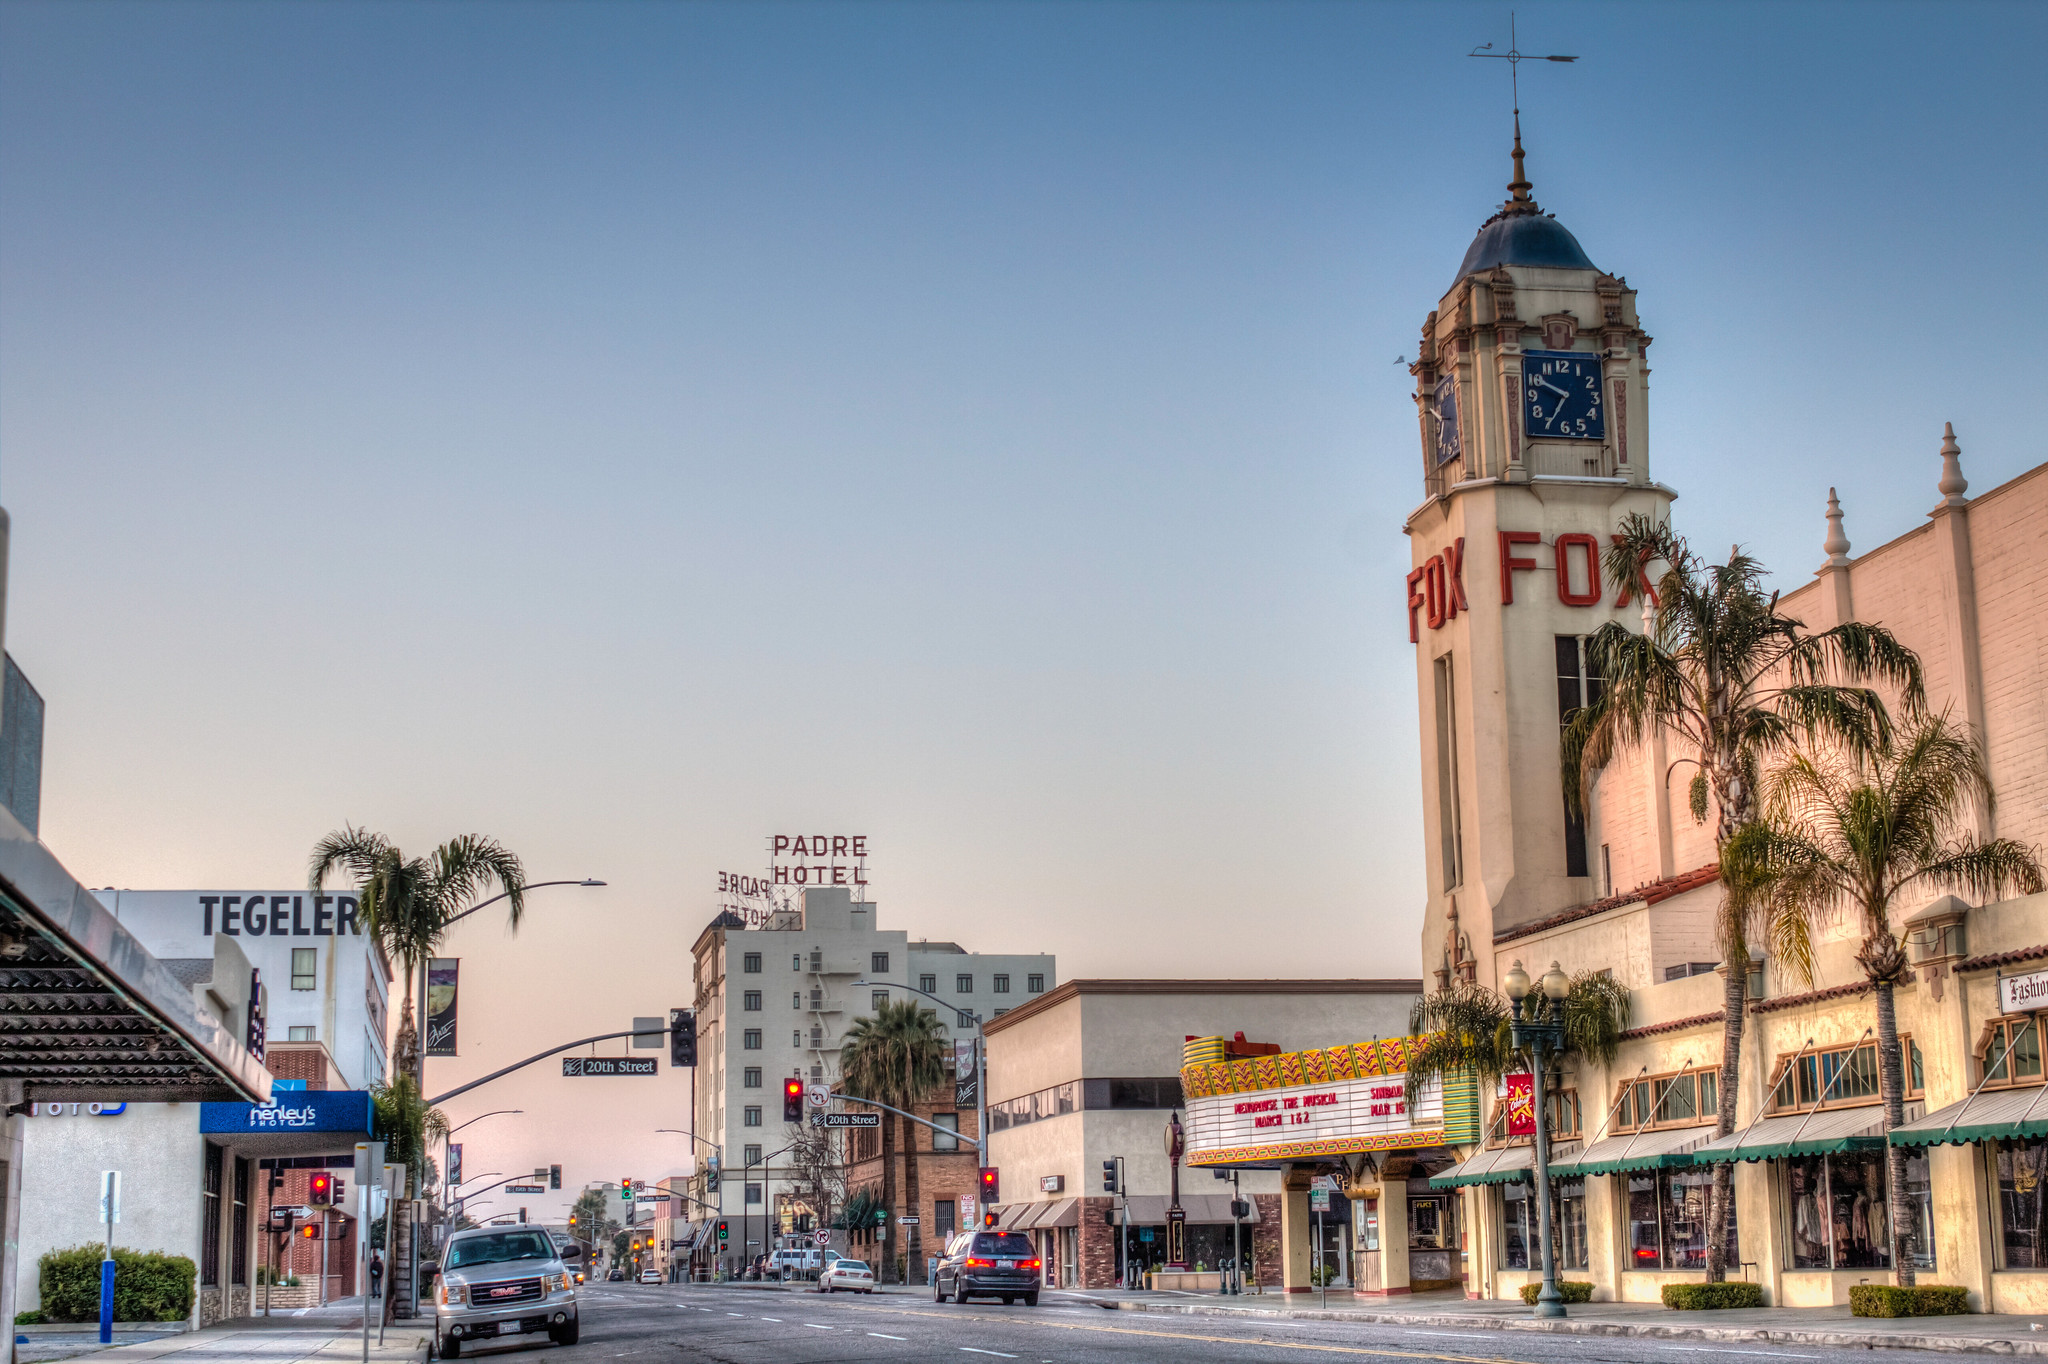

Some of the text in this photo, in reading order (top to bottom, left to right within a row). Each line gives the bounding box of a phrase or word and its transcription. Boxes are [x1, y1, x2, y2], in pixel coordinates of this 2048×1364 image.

[1542, 362, 1552, 376] 11
[1556, 360, 1570, 374] 12
[1576, 364, 1580, 376] 1
[1528, 373, 1543, 386] 10
[1586, 376, 1595, 388] 2
[1528, 390, 1538, 402] 9
[1590, 392, 1600, 405] 3
[1532, 406, 1543, 418] 8
[1586, 408, 1597, 420] 4
[1545, 417, 1554, 430] 7
[1560, 420, 1570, 434] 6
[1576, 418, 1586, 432] 5
[1407, 537, 1468, 643] FOX
[774, 835, 868, 857] PADRE
[774, 866, 868, 885] HOTEL
[199, 896, 362, 936] TEGELER
[2009, 975, 2048, 1005] Fashio
[587, 1061, 654, 1072] 20th Street
[1370, 1085, 1404, 1100] SINBAD
[1282, 1097, 1299, 1110] THE
[1303, 1092, 1339, 1107] MUSICAL
[250, 1104, 316, 1126] henley's
[1370, 1102, 1391, 1116] MAR
[828, 1116, 877, 1124] 20th Street
[1254, 1114, 1282, 1128] MARCH
[490, 1286, 523, 1297] GMC
